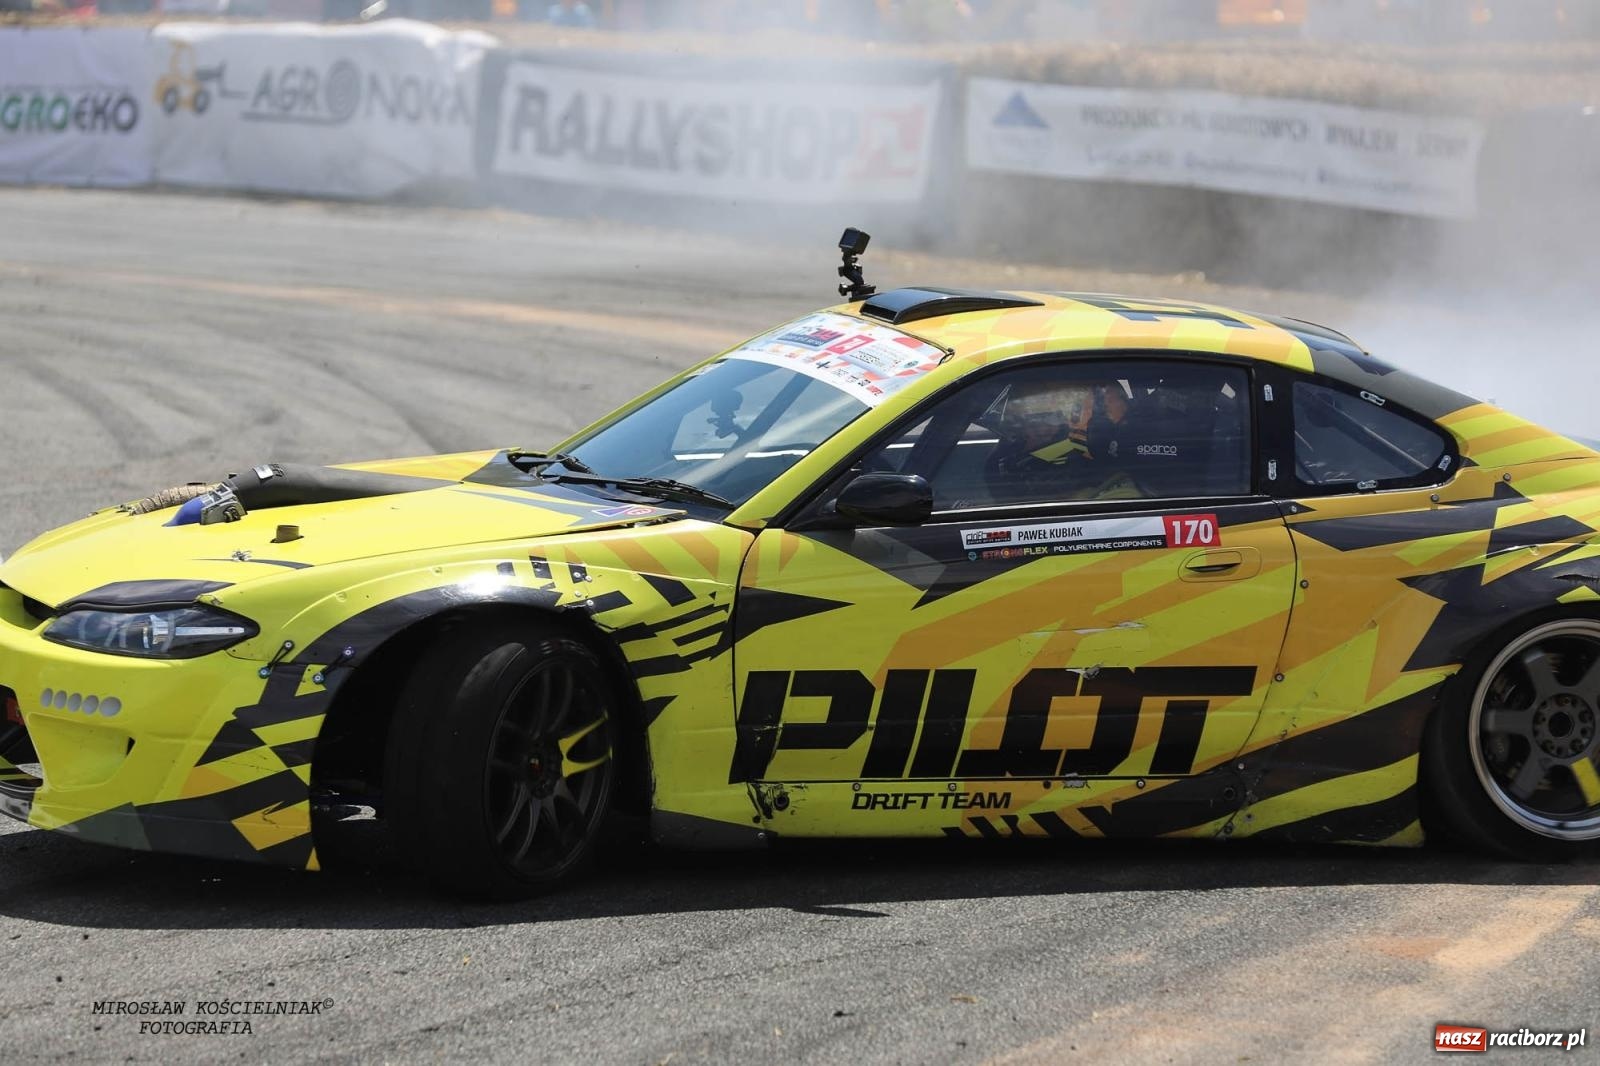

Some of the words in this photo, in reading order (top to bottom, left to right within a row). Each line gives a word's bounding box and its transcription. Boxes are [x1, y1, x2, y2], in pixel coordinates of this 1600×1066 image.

[0, 94, 139, 133] GROEKO
[510, 83, 857, 181] RALLYSHOP
[1137, 444, 1177, 456] sparco
[1018, 529, 1048, 542] PAWEŁ
[1050, 526, 1083, 539] KUBIAK
[1172, 519, 1213, 545] 170
[1053, 543, 1113, 553] POLYURETHANE
[1113, 539, 1163, 549] COMPONENTS
[728, 666, 1258, 784] PILOT
[851, 792, 934, 810] DRIFT
[940, 792, 1012, 810] TEAM
